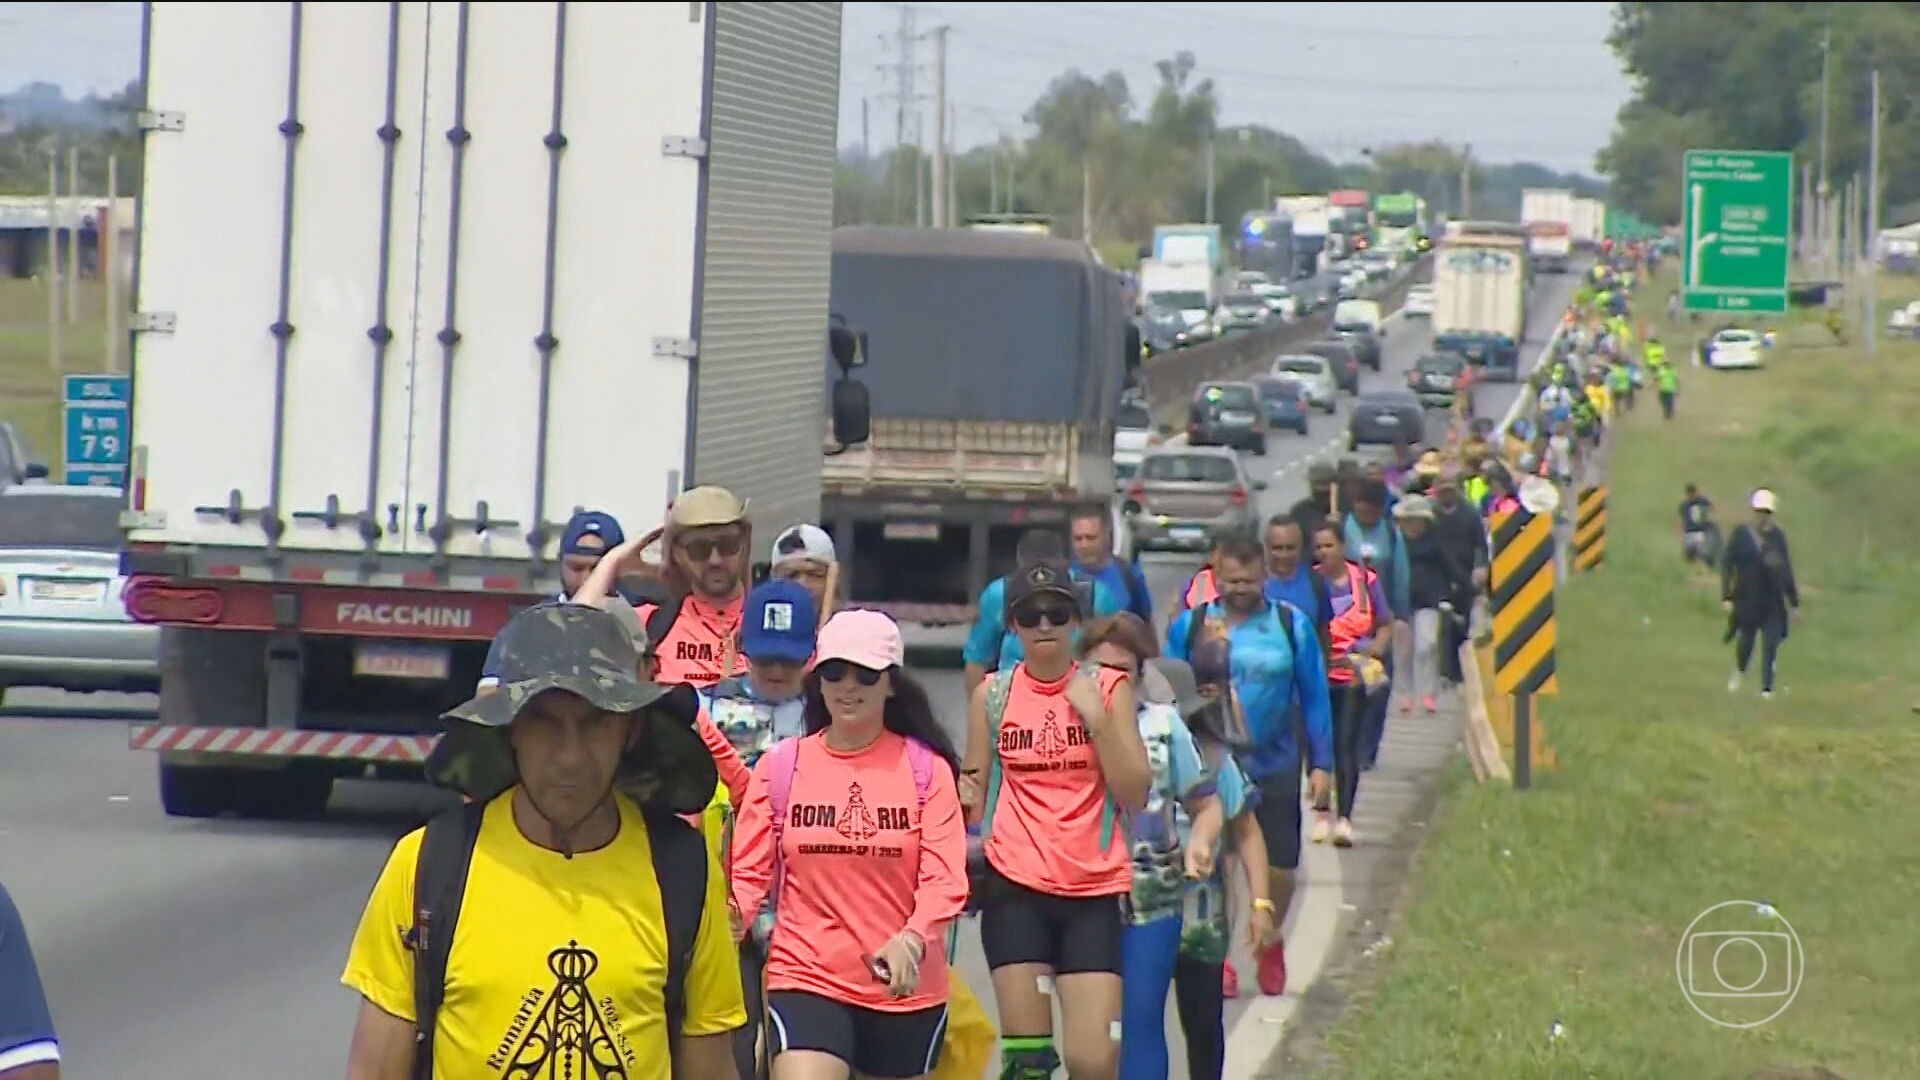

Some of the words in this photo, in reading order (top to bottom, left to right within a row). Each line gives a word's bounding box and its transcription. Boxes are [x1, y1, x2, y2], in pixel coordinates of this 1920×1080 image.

[80, 435, 120, 459] 79
[336, 602, 472, 628] FACCHINI
[486, 987, 544, 1071] Romaria
